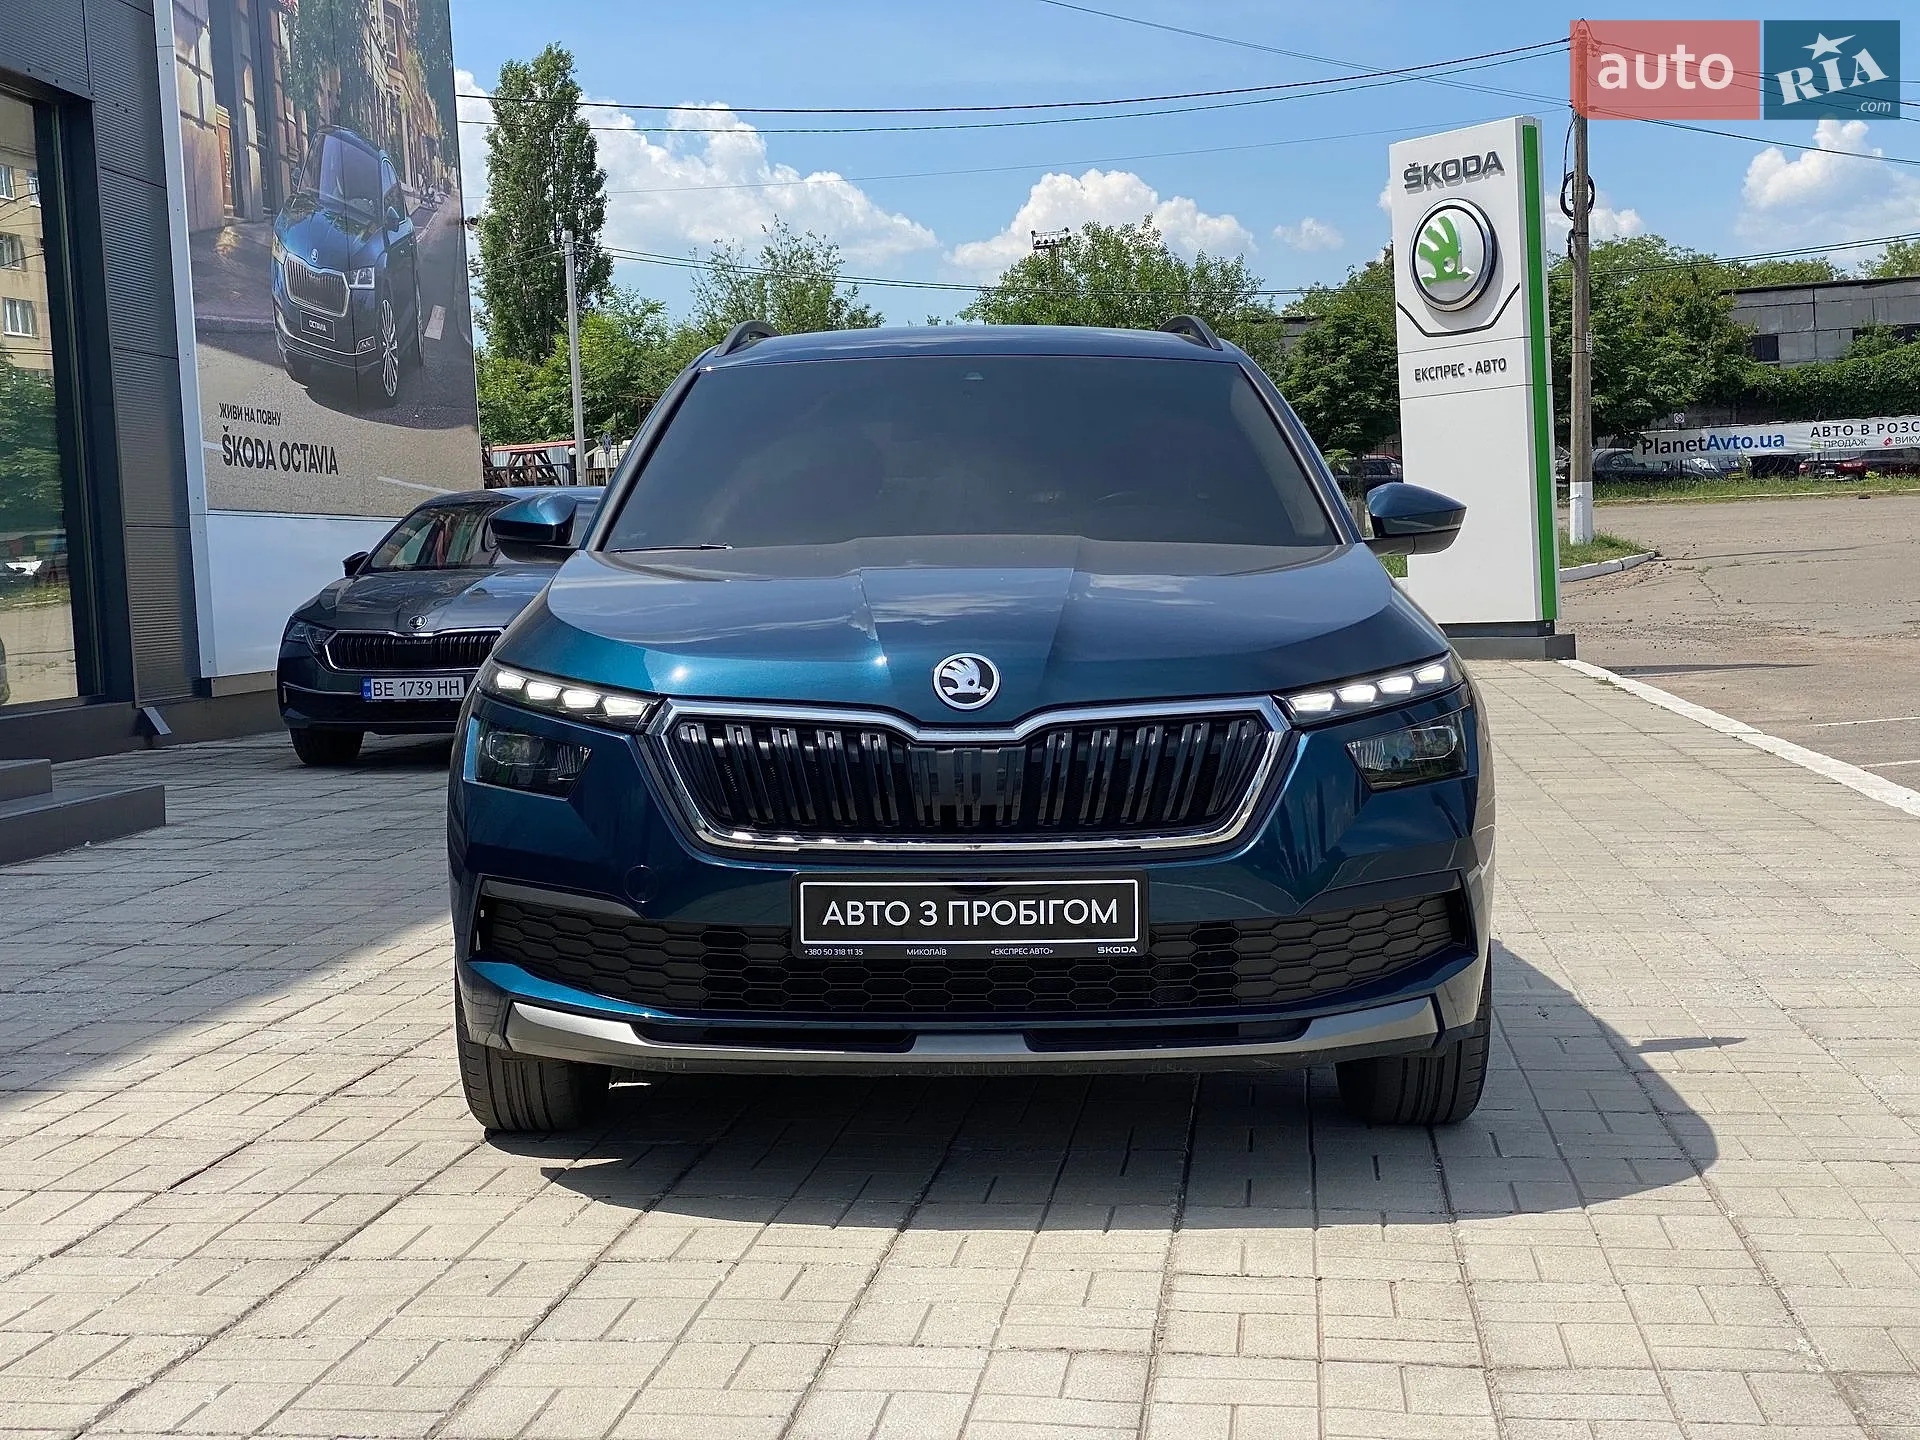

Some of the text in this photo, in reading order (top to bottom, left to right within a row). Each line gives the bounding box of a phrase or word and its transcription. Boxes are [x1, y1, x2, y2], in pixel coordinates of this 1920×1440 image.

[1404, 150, 1505, 189] ŠKODA
[1414, 362, 1465, 382] ЕКСПРЕС
[1475, 357, 1507, 376] АВТО
[219, 402, 282, 426] ЖИВИ НА ПОВНУ
[1810, 421, 1920, 438] АВТО В РОЗС
[221, 424, 339, 475] ŠKODA OCTAVIA
[1642, 434, 1785, 455] PlanetAvto.ua
[1824, 439, 1867, 448] ПРОДАЖ
[373, 680, 460, 697] BE 1739 HH
[822, 900, 911, 926] АВТО
[948, 898, 1118, 926] ПРОБІГОМ
[823, 948, 833, 956] 50
[834, 948, 846, 956] 318
[854, 948, 864, 956] 35
[906, 948, 948, 956] МИКОЛАЇВ
